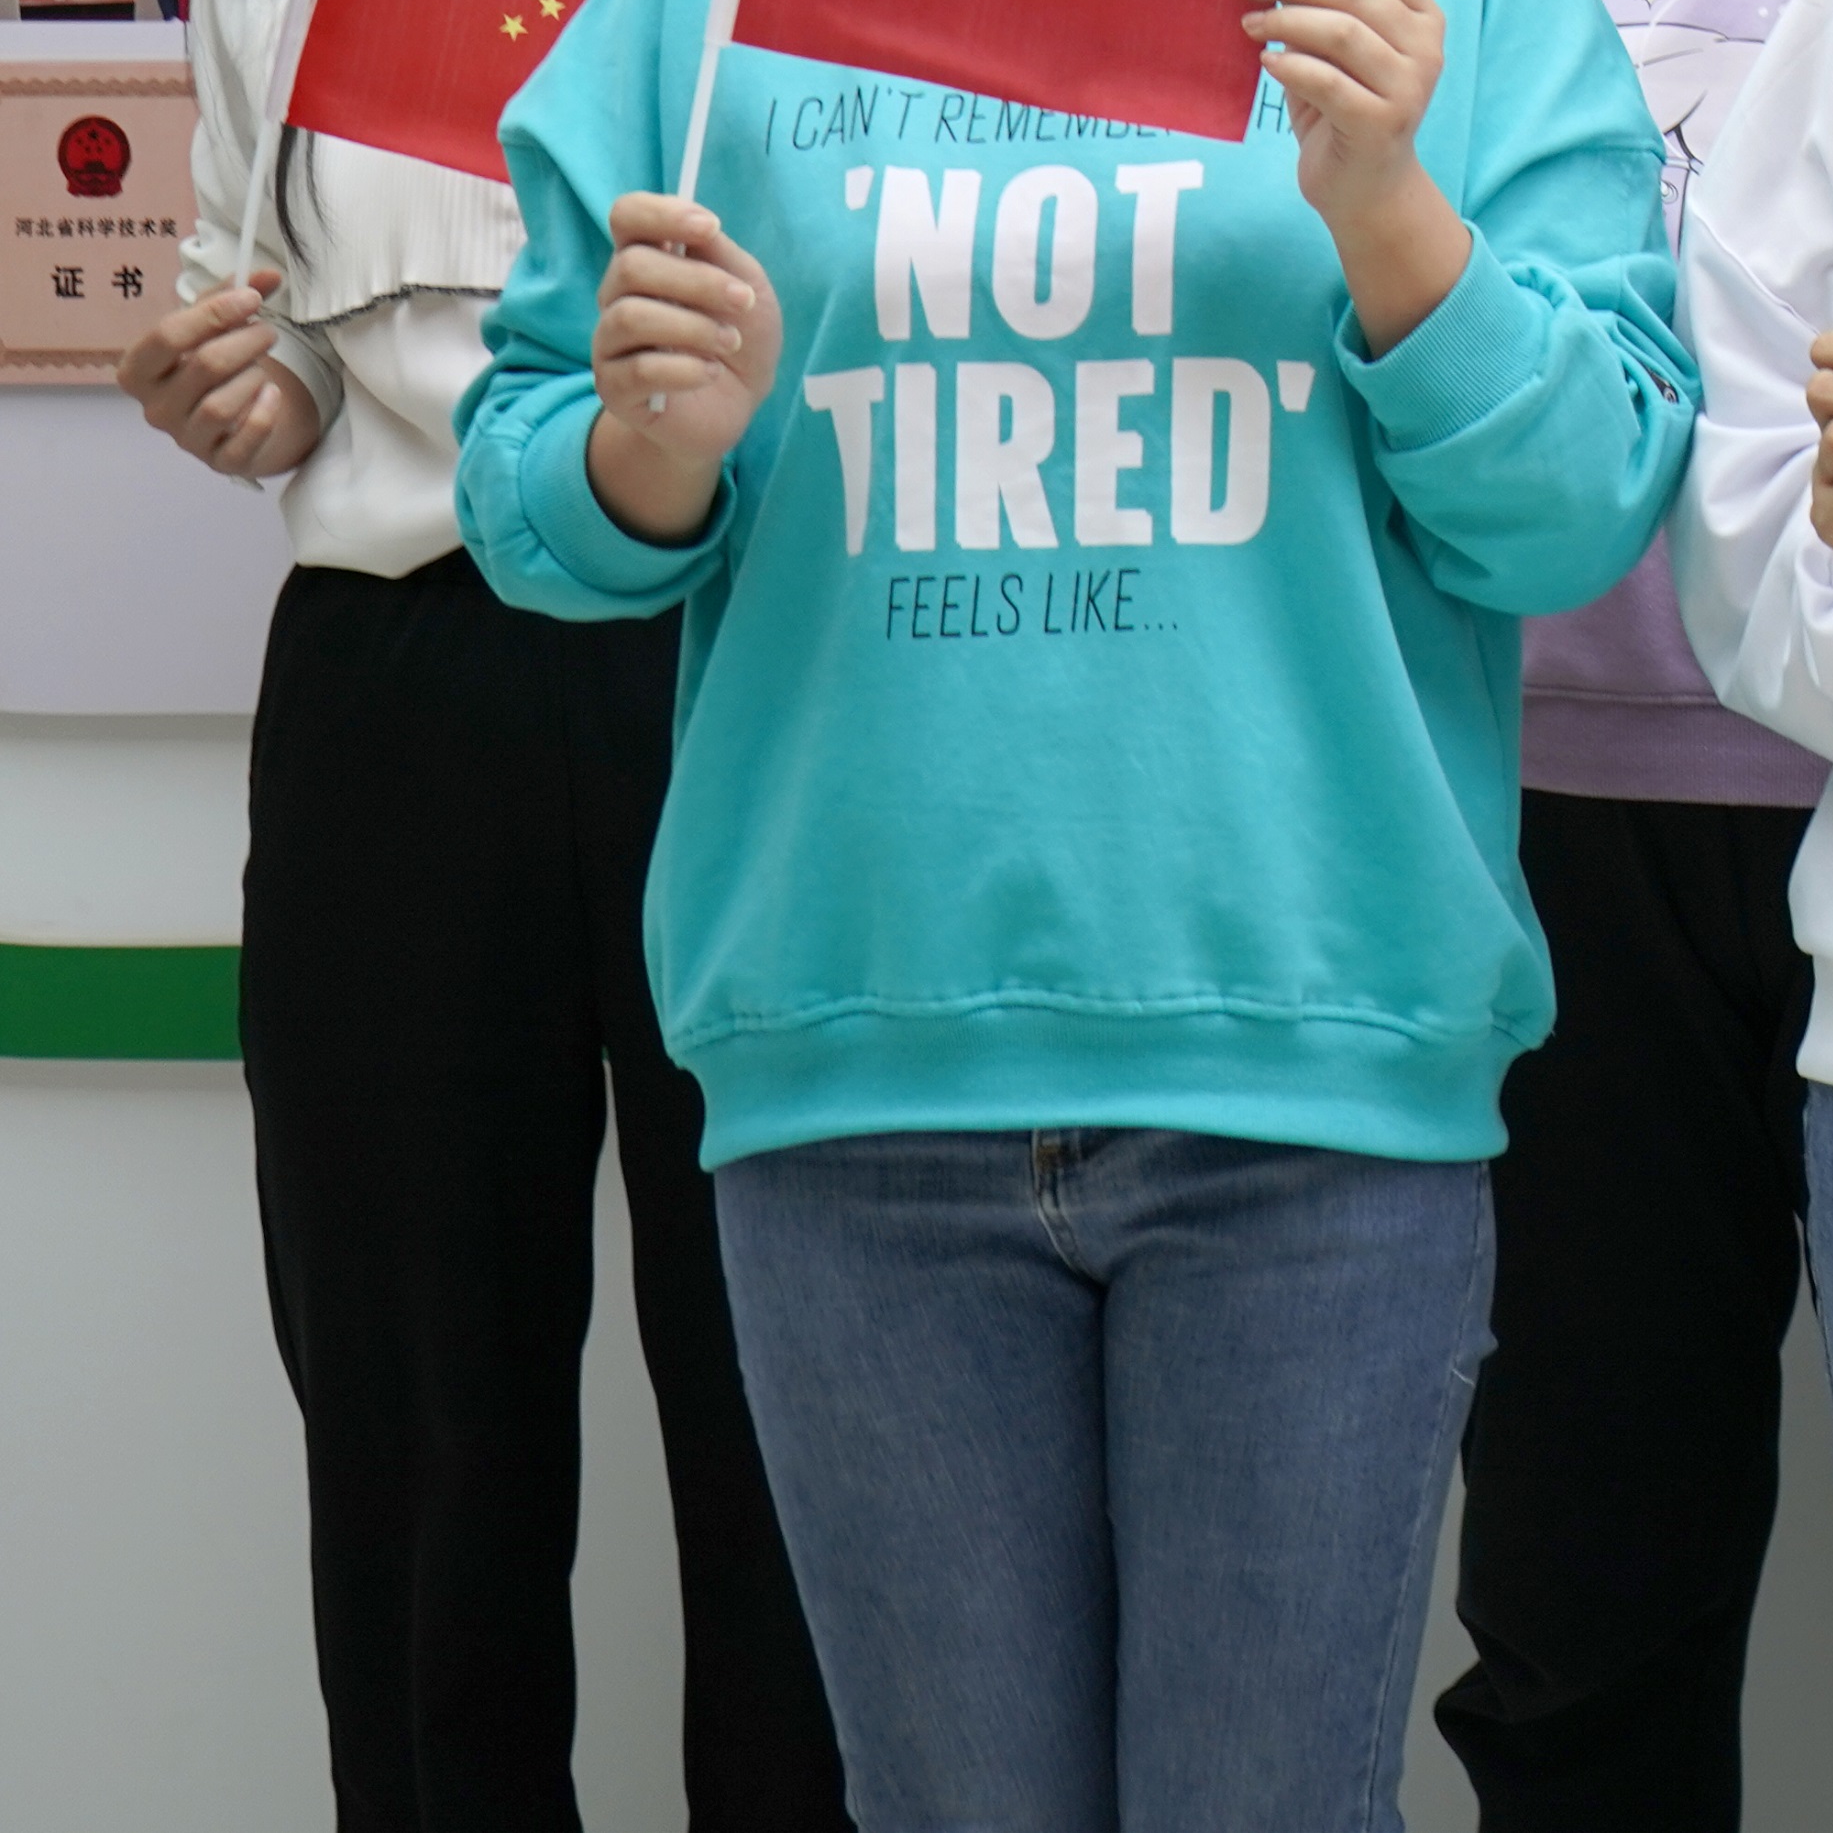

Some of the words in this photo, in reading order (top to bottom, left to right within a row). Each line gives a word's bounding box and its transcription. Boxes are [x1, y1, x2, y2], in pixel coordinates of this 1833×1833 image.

[763, 97, 778, 156] I
[792, 83, 924, 152] CAN'T
[885, 572, 1024, 642] FEELS
[1042, 568, 1179, 633] LIKE...
